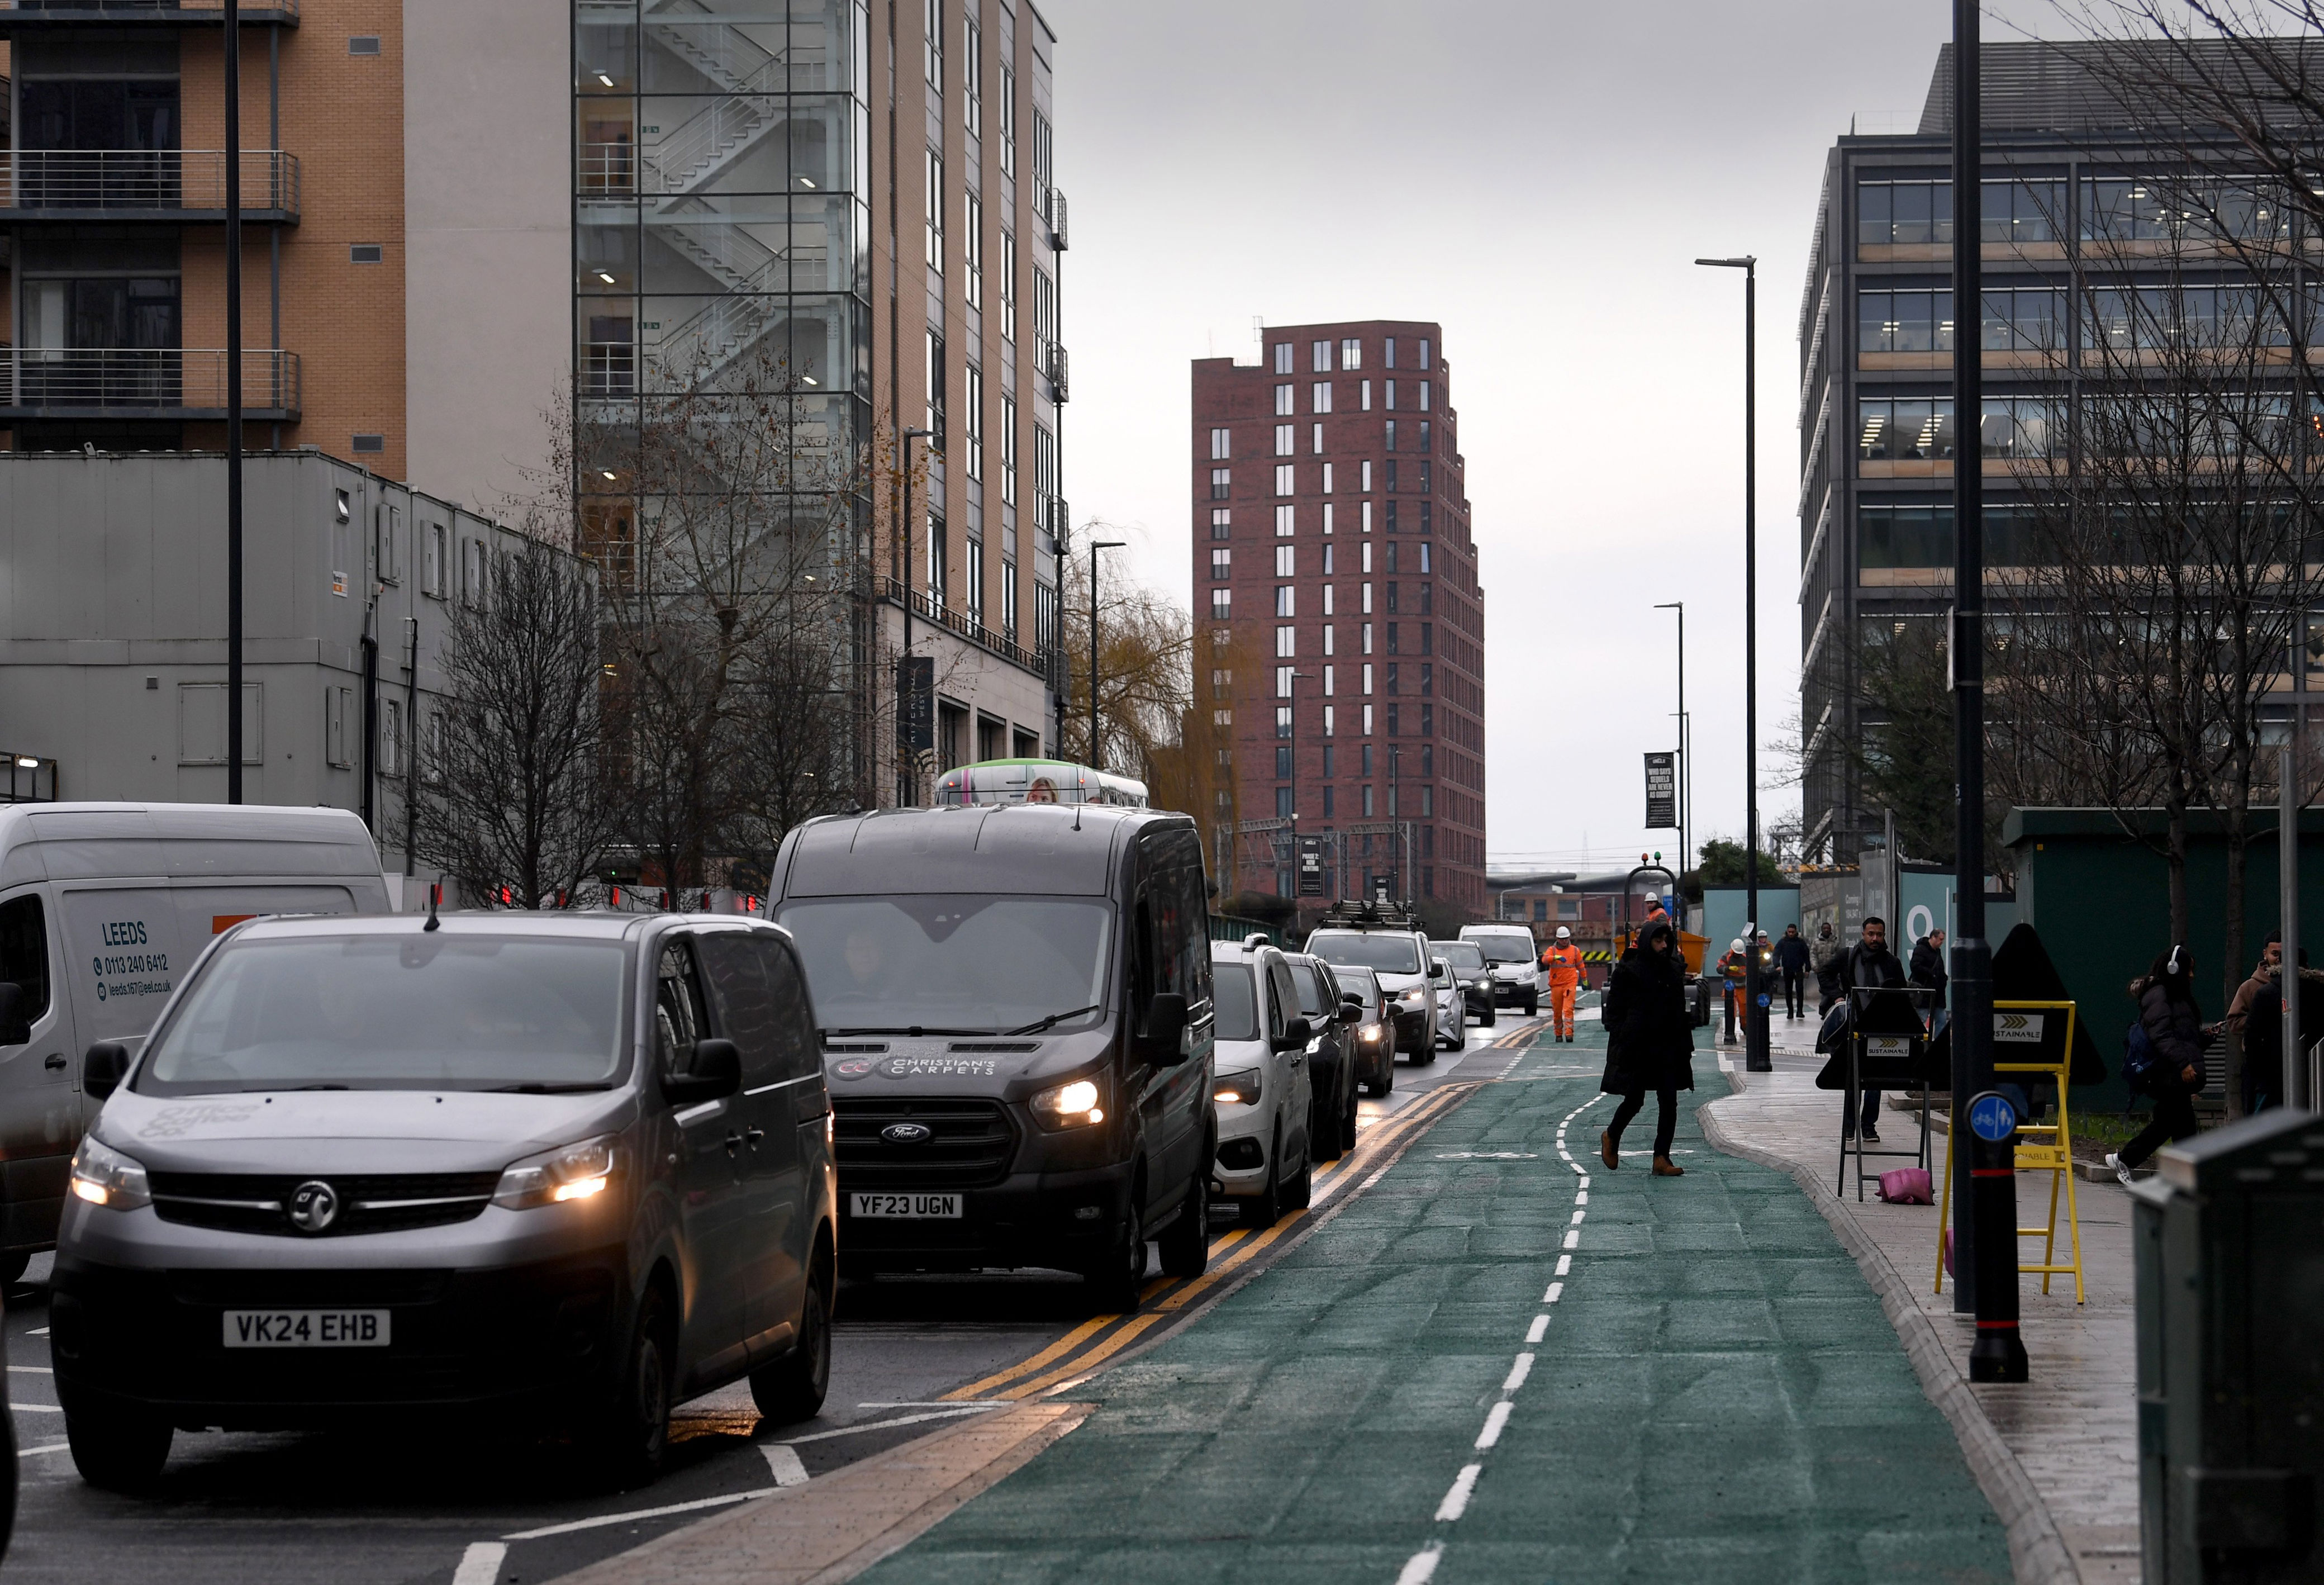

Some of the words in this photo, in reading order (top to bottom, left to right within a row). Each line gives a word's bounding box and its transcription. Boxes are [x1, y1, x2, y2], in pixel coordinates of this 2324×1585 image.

[102, 921, 147, 946] LEEDS
[105, 957, 126, 974] 0113
[127, 956, 144, 972] 240
[146, 954, 168, 971] 6412
[891, 1066, 994, 1075] CARPETS
[893, 1059, 995, 1068] CHRISTIAN'S
[892, 1127, 919, 1138] Ford
[859, 1196, 910, 1214] YF23
[916, 1197, 954, 1214] UGN
[237, 1315, 311, 1341] VK24
[321, 1315, 377, 1340] EHB
